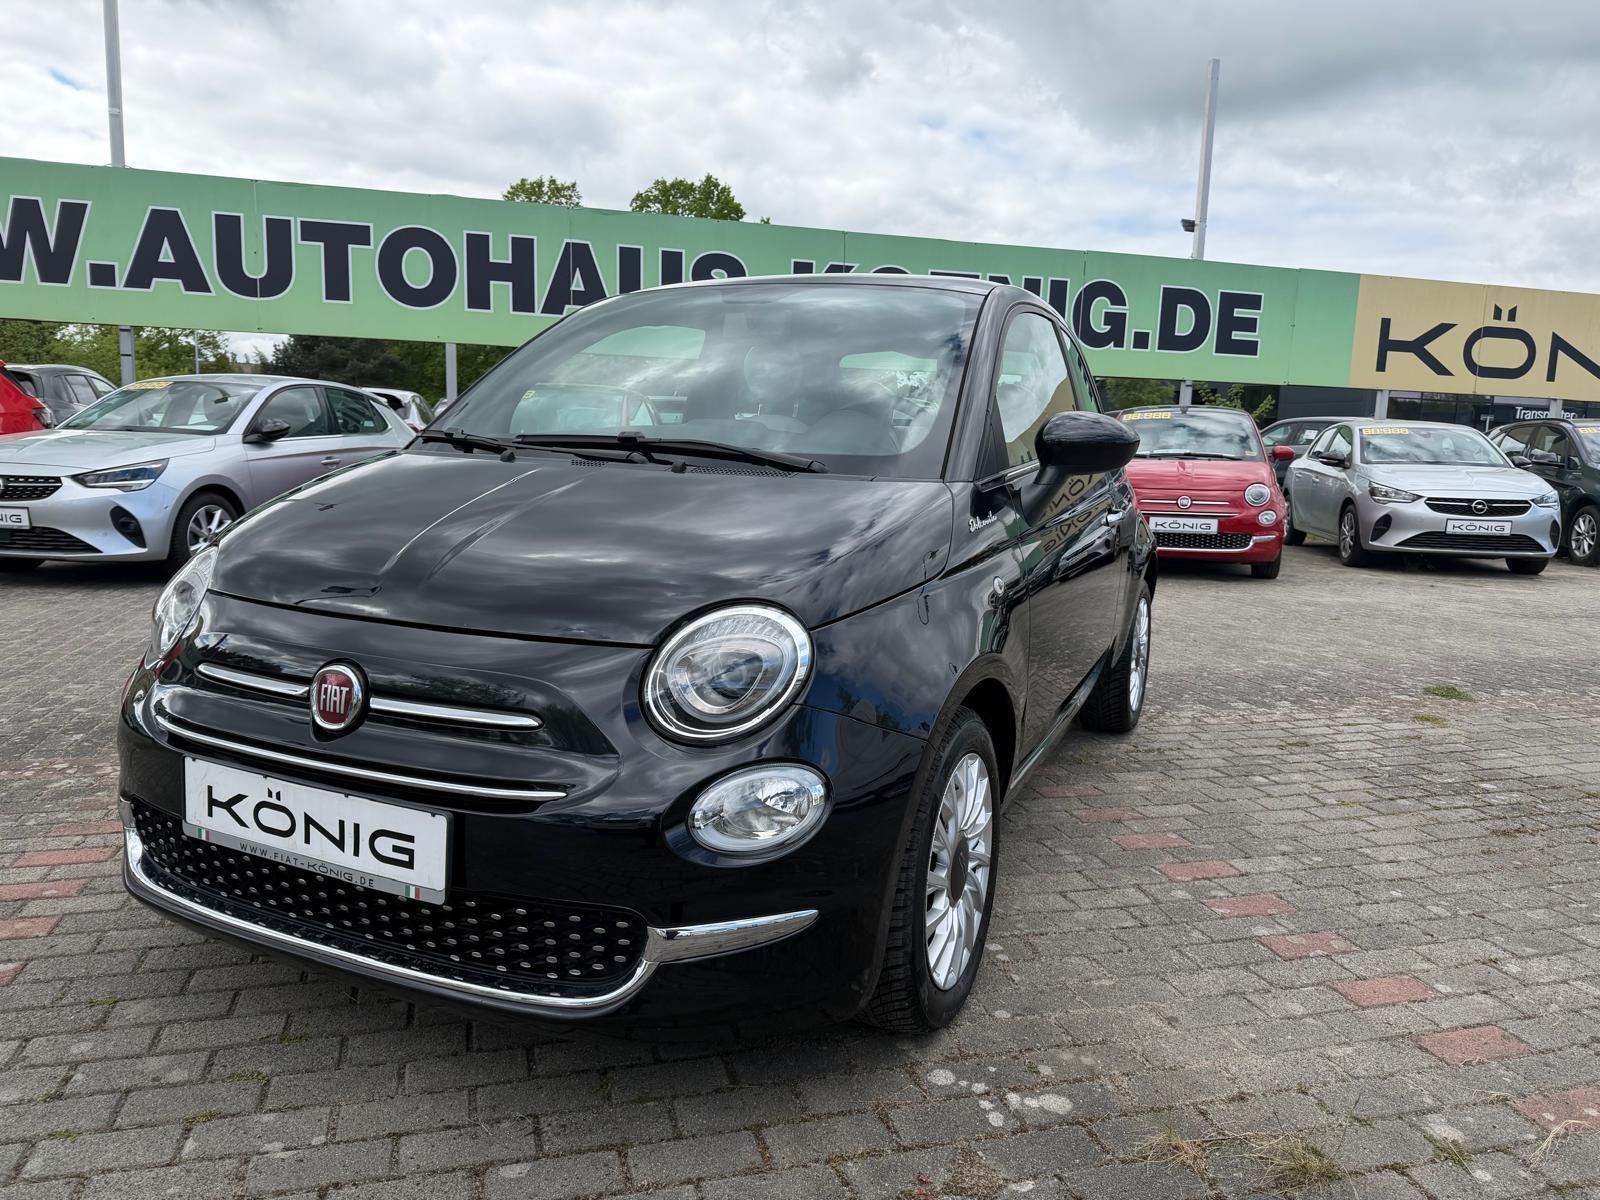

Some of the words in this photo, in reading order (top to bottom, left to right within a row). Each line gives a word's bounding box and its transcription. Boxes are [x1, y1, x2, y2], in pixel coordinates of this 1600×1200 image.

[1515, 406, 1577, 420] Transter
[0, 514, 22, 523] IG
[1155, 520, 1212, 530] KÖNIG
[1452, 522, 1506, 532] KÖNIG
[320, 683, 350, 714] FIAT
[207, 784, 415, 870] KÖNIG
[239, 842, 374, 888] WWW.FIAT-KÖNIG.DE
